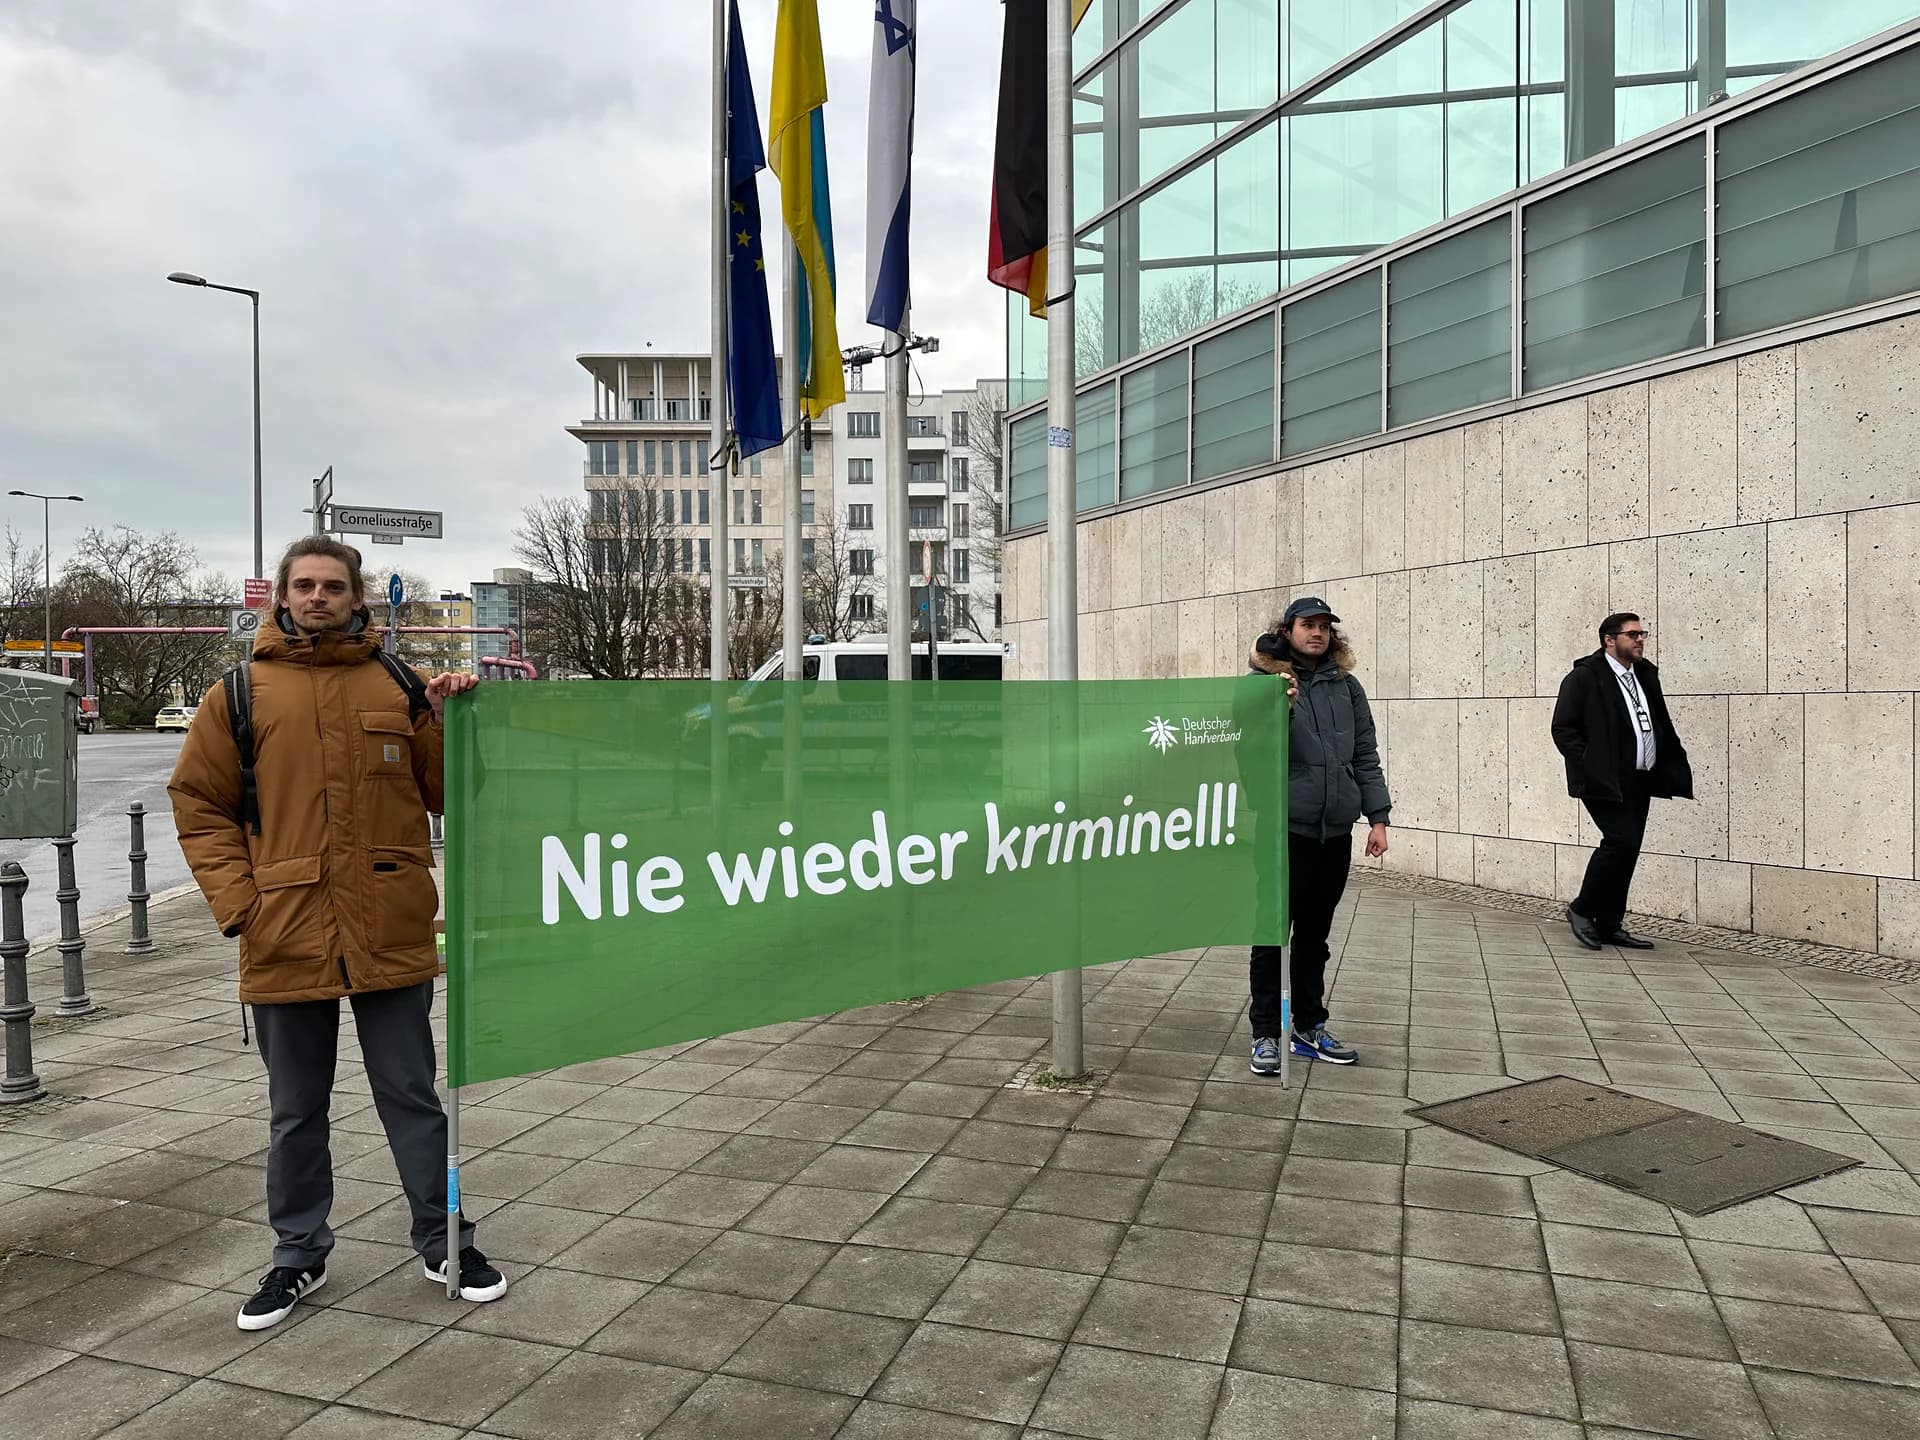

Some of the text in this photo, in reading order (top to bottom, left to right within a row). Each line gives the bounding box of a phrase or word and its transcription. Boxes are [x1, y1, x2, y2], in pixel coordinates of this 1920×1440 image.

[340, 511, 433, 531] Corneliusstraße
[241, 617, 254, 626] 30
[1182, 716, 1232, 732] Deutscher
[1184, 728, 1242, 745] Hanfverband
[541, 782, 1238, 924] Nie wieder kriminell!
